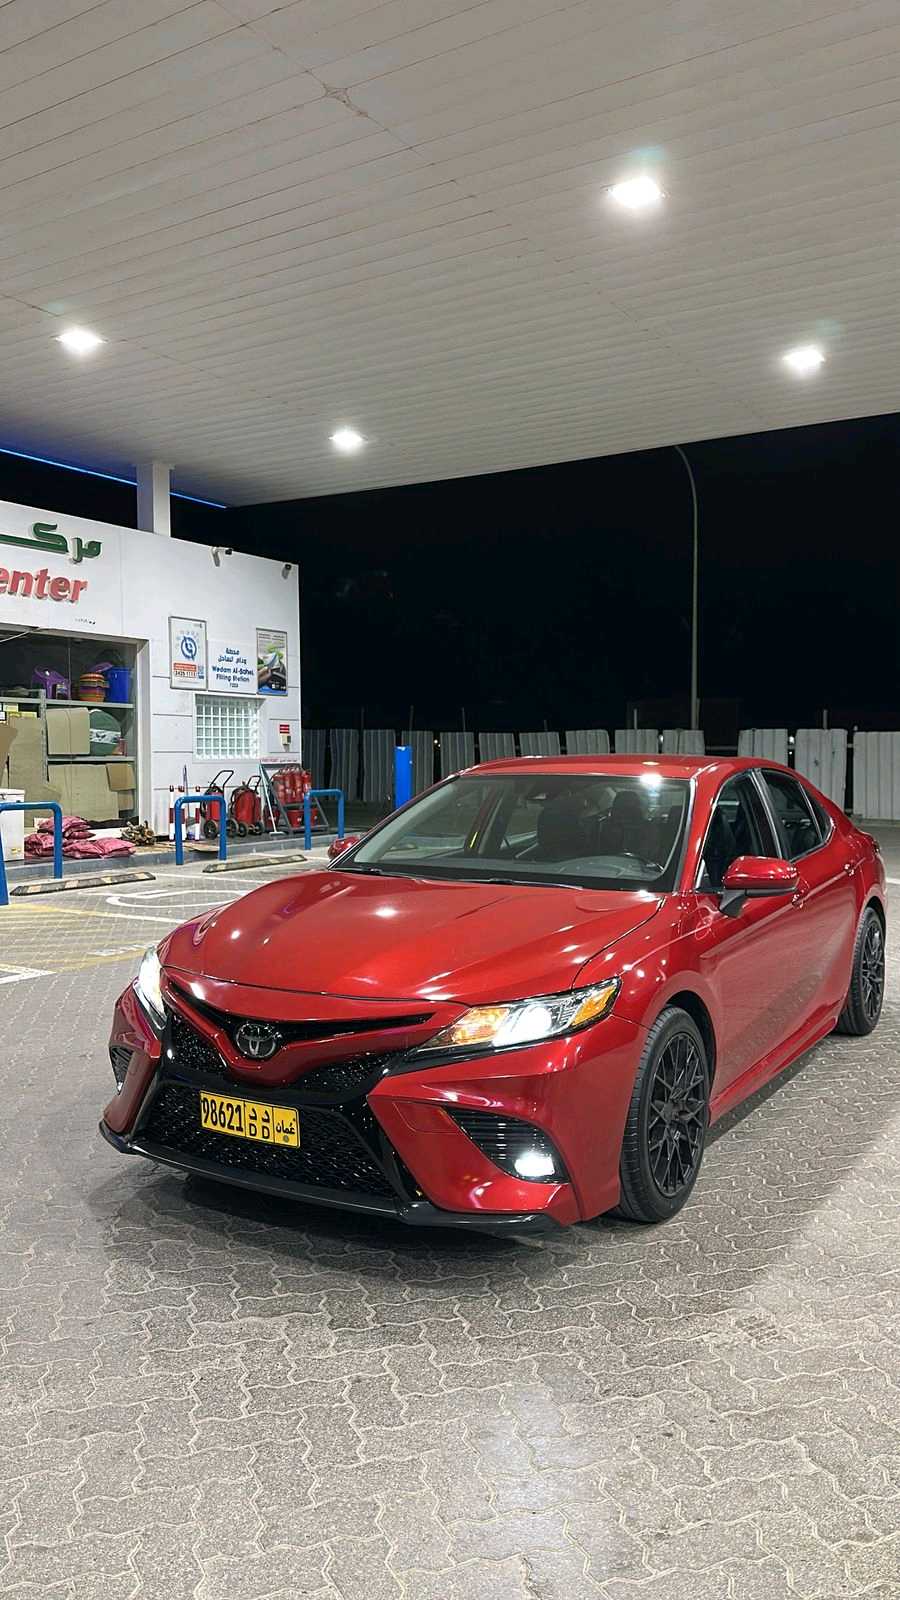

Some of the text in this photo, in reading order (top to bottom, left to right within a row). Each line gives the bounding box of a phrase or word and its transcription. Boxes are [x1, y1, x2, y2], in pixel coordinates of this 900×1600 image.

[201, 1097, 243, 1132] 98621
[249, 1123, 271, 1140] D D
